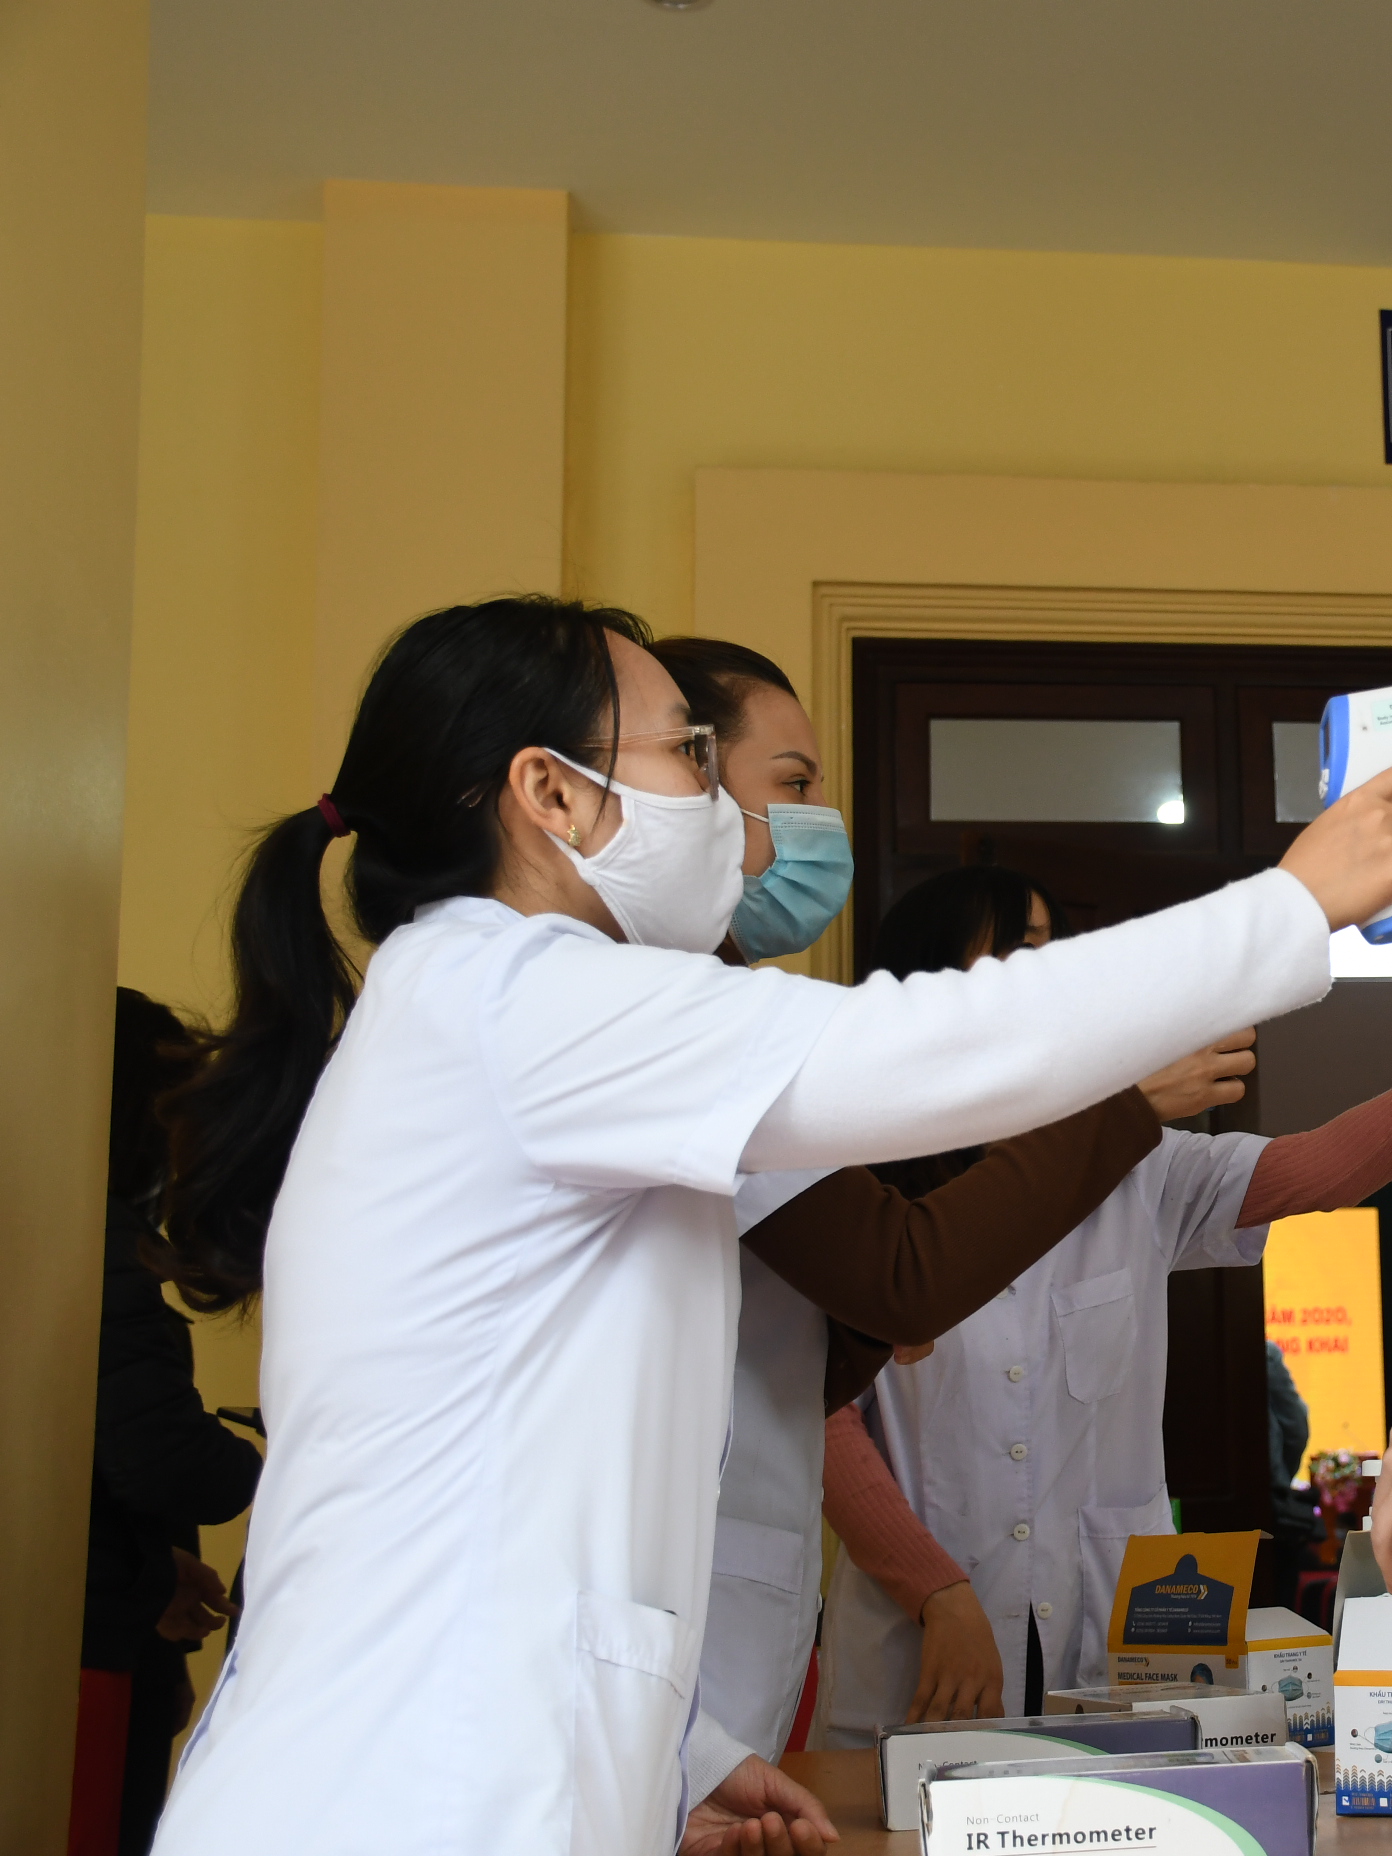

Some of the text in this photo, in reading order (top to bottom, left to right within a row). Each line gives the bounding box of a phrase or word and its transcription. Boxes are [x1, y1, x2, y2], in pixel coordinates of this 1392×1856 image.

[1155, 1584, 1199, 1594] DANAMECO
[1117, 1671, 1178, 1682] MEDICAL FACE MASK
[1203, 1731, 1277, 1748] mometer
[966, 1824, 1157, 1851] IR Thermometer
